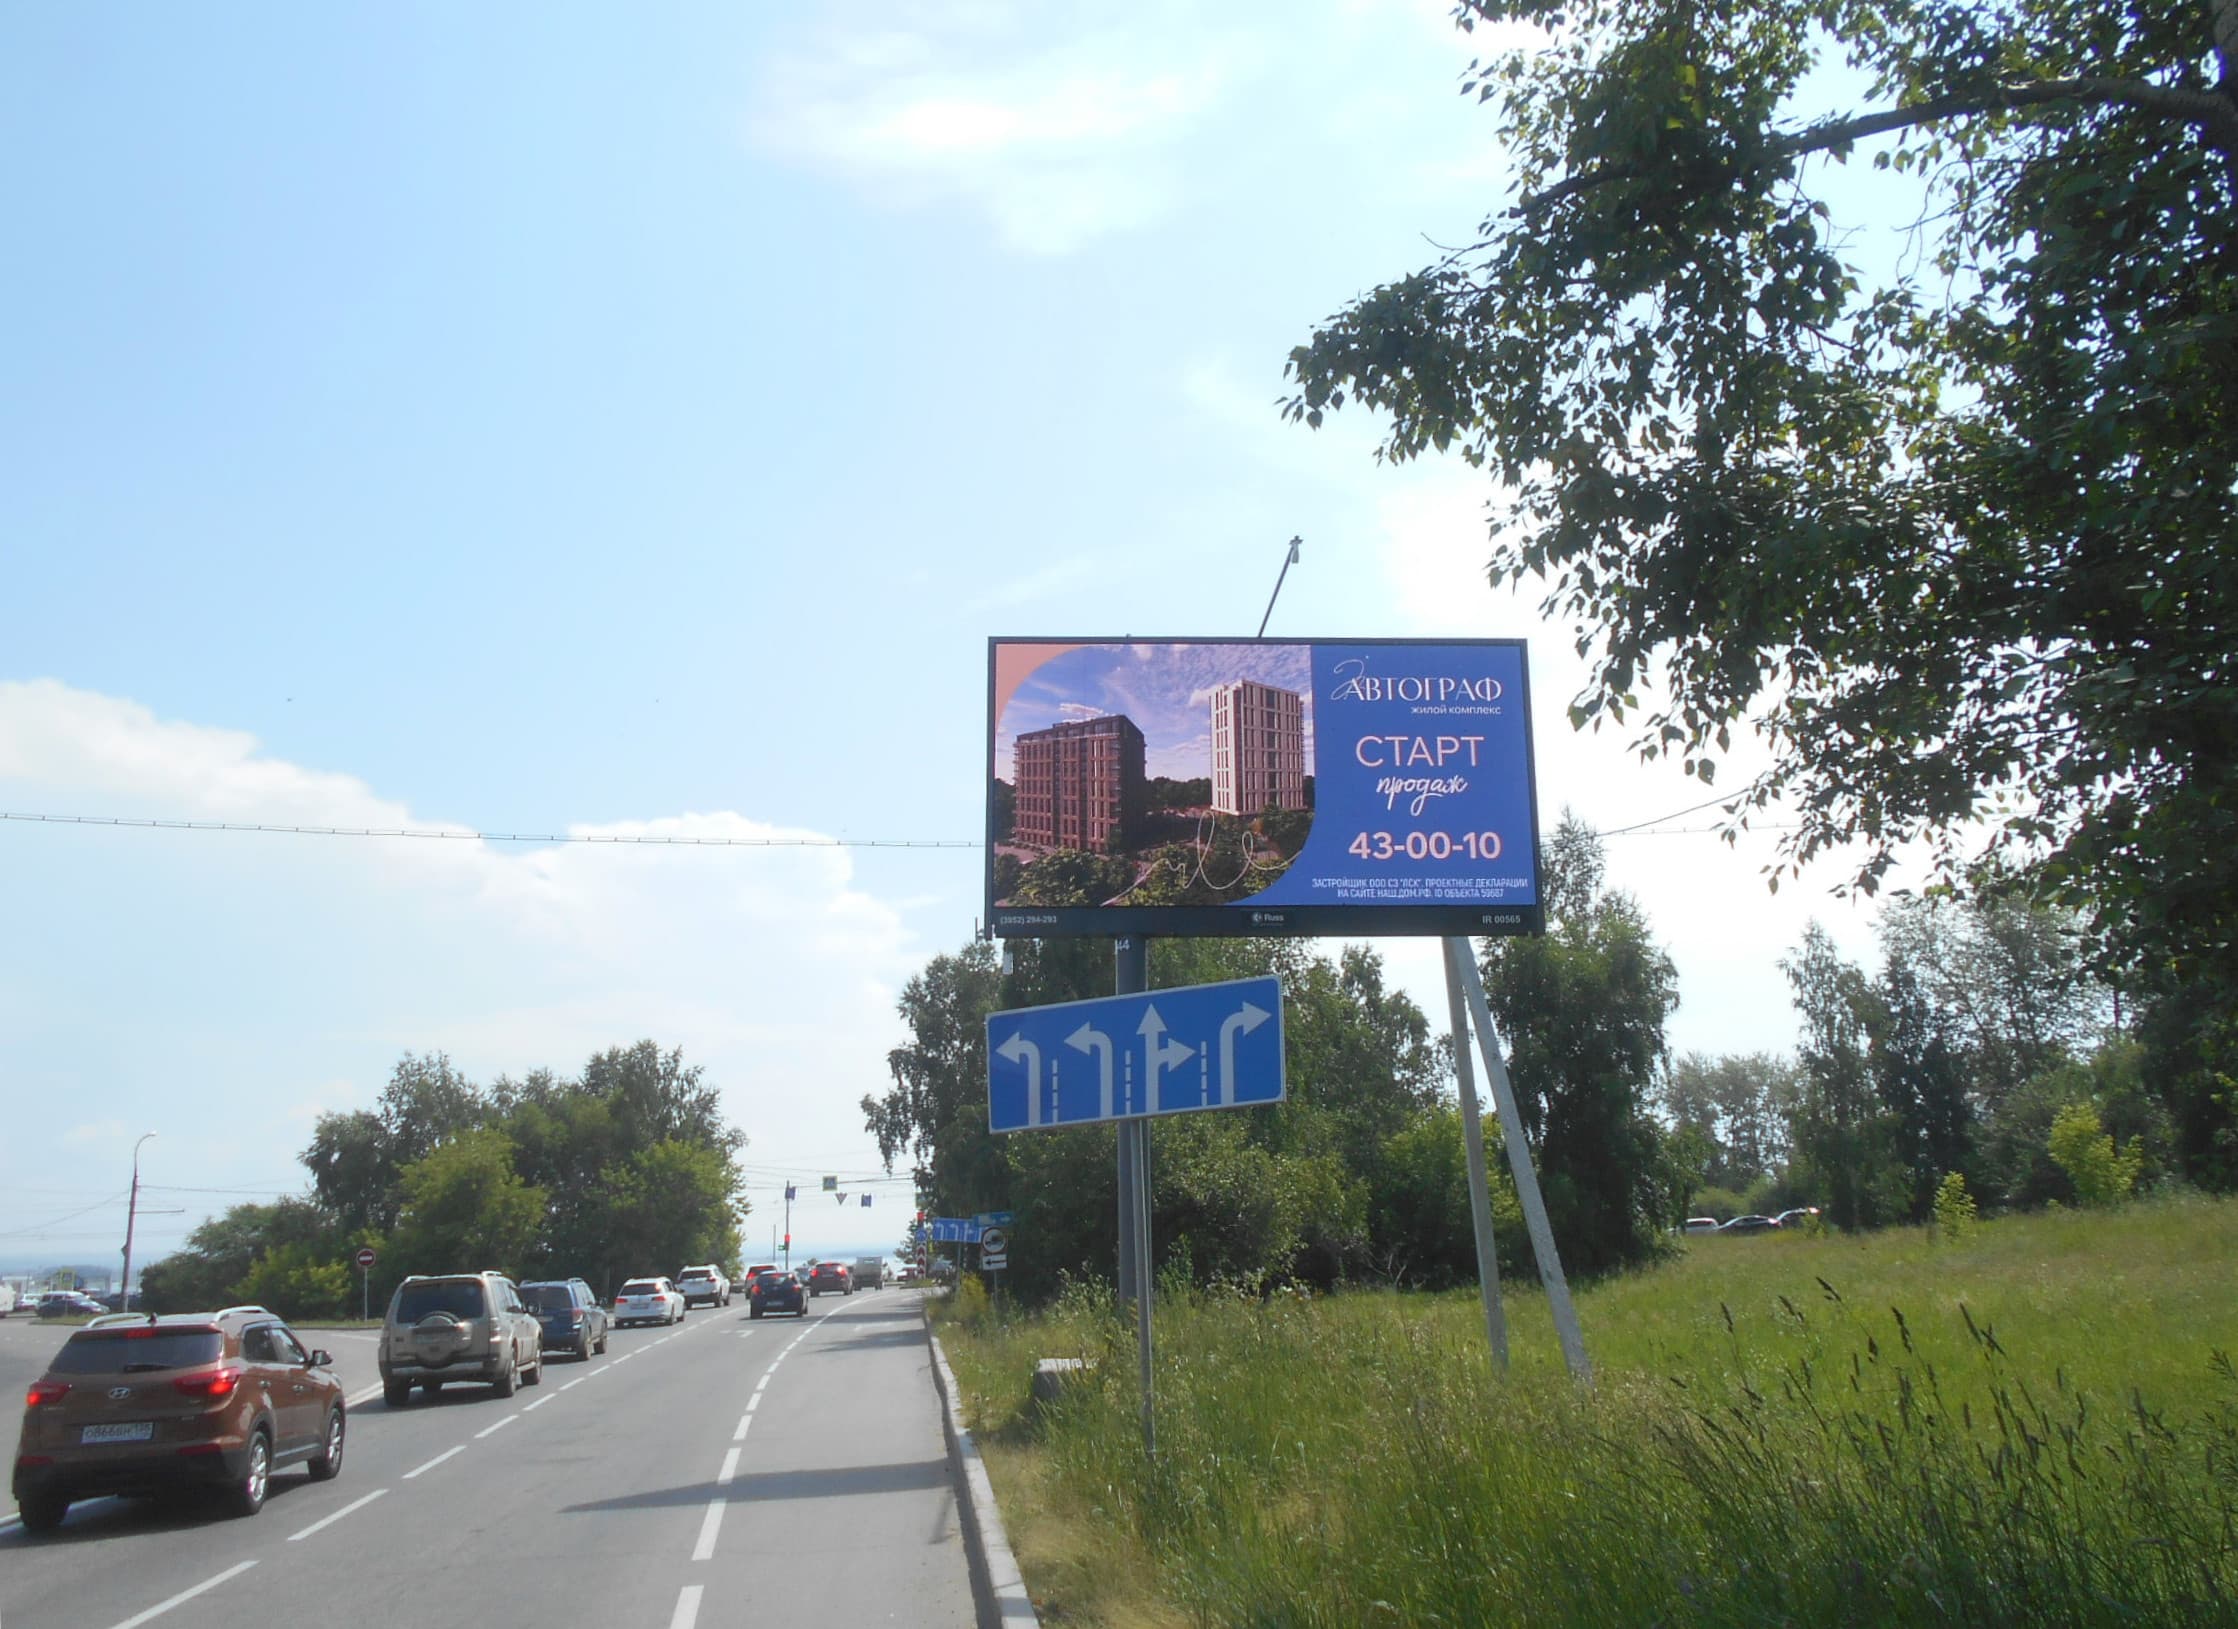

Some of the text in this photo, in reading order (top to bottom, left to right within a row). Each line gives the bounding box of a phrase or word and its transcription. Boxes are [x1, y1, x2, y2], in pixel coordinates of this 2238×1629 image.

[1346, 676, 1503, 702] АВТОГРАФ
[1411, 704, 1502, 715] жилой комплекс
[1355, 735, 1485, 767] СТАРТ
[1376, 775, 1468, 817] продаж
[1348, 831, 1502, 860] 43-00-10
[1312, 877, 1368, 888] ЗАСТРОЙЩИК
[1369, 878, 1386, 888] ООО
[1426, 878, 1474, 888] ПРОЕКТНЫЕ
[1475, 878, 1528, 889] ДЕКЛАРАЦИИ
[1337, 888, 1349, 898] НА
[1350, 887, 1376, 898] САЙТЕ
[1444, 888, 1480, 898] ОБЪЕКТА
